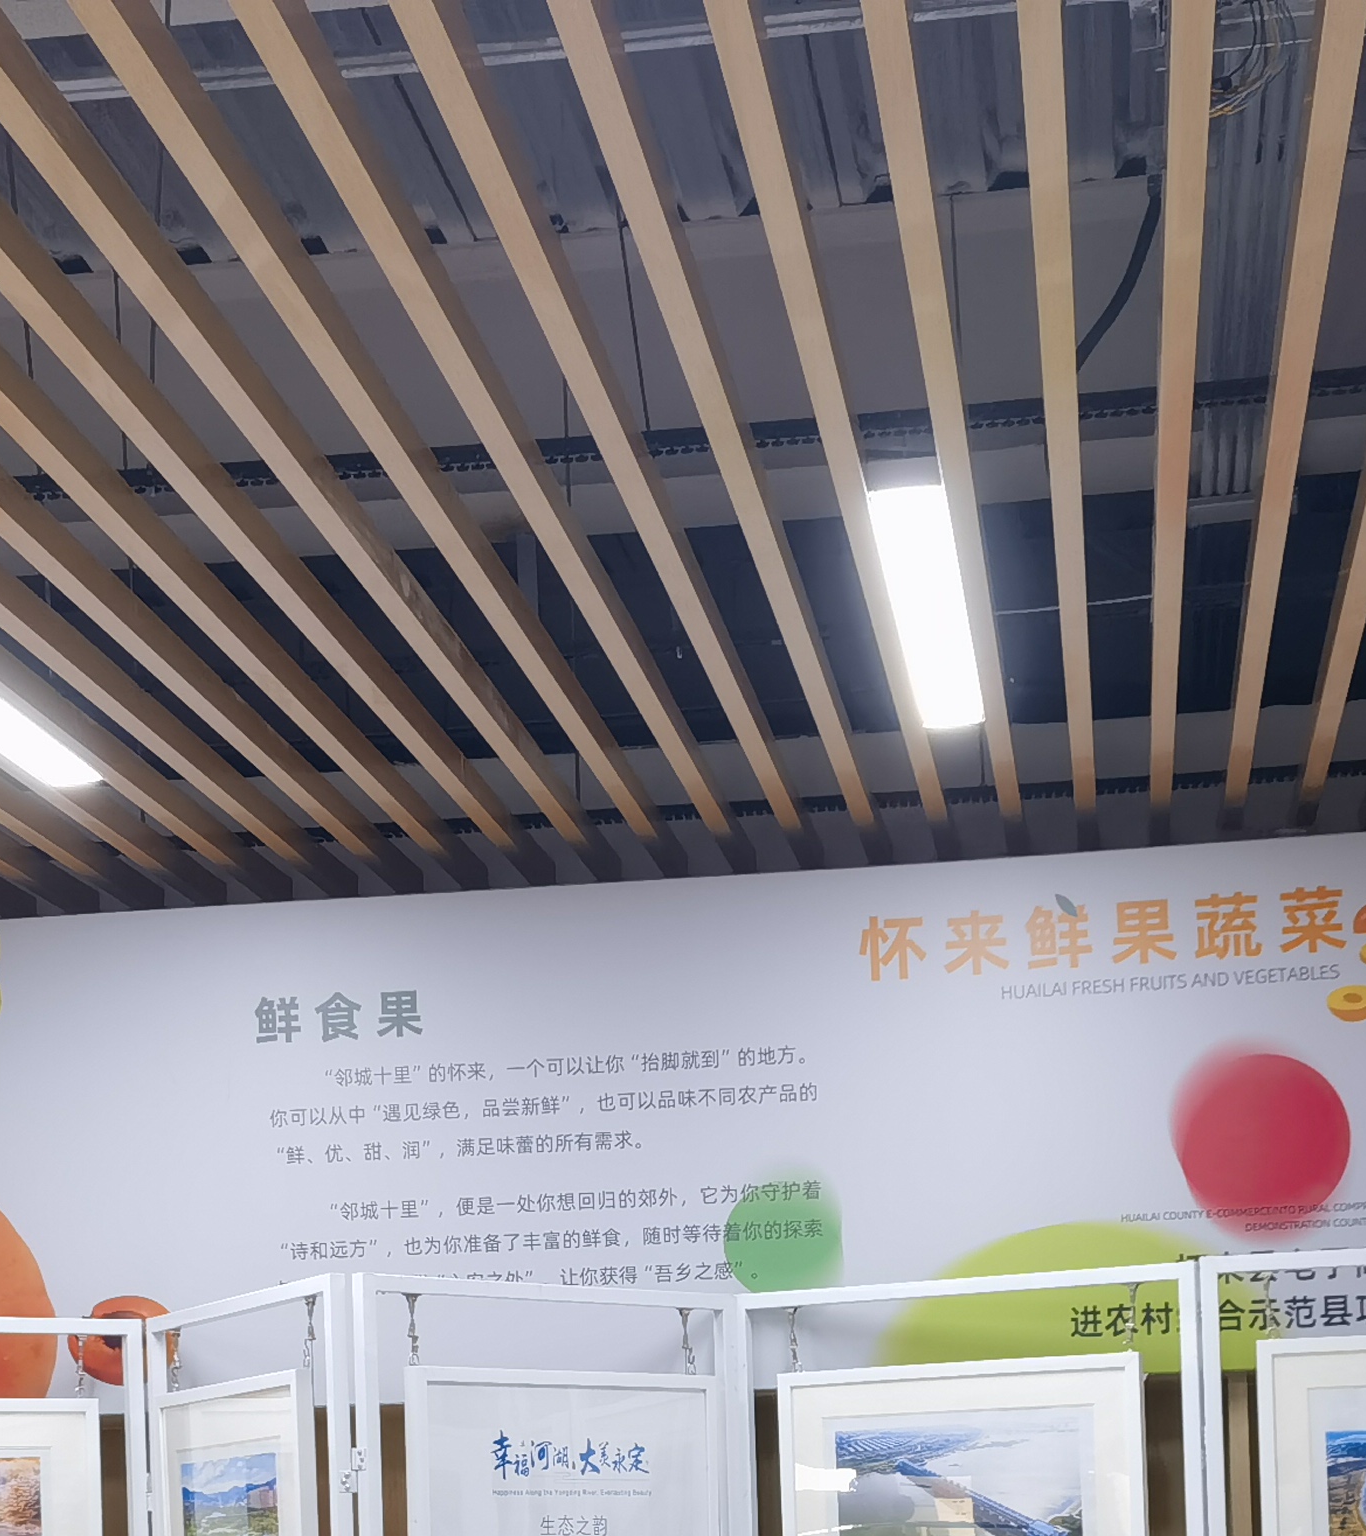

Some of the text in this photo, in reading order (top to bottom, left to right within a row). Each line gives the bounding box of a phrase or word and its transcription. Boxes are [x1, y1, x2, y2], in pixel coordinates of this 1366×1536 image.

[859, 886, 1347, 982] 怀来鲜果蔬菜
[1001, 964, 1340, 1000] HUAILAI FRESH FRUITS AND VEGETABLES
[254, 990, 423, 1044] 鲜食果
[1121, 1211, 1161, 1222] HUAILAI
[1163, 1209, 1204, 1221] COUNTY
[1245, 1218, 1331, 1232] DEMONSTRATION
[540, 1514, 608, 1536] 生态之韵
